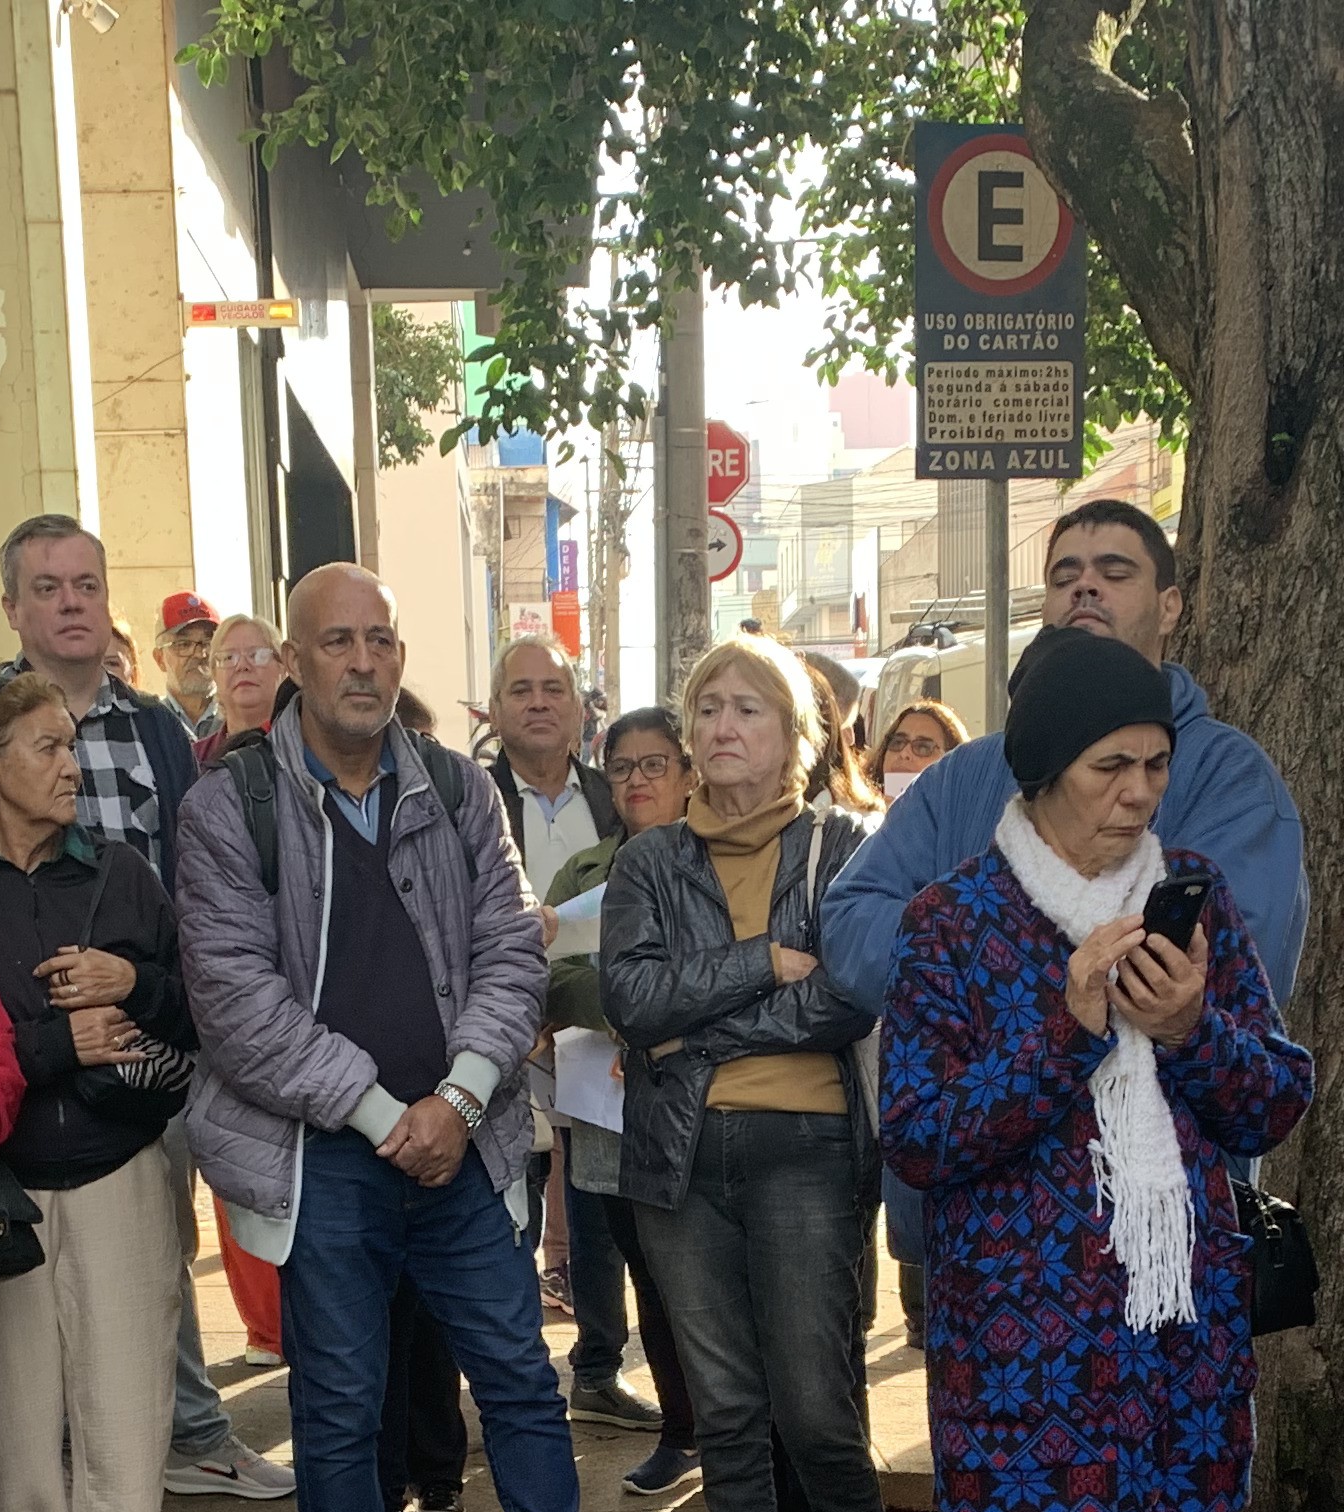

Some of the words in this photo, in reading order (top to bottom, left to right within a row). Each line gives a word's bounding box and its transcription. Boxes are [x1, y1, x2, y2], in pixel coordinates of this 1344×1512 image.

[978, 171, 1024, 262] E
[220, 304, 265, 312] CUIDADO
[924, 313, 956, 330] USO
[963, 309, 1075, 330] OBRIGATÓRIO
[943, 334, 970, 350] DO
[978, 331, 1059, 350] CARTÃO
[928, 381, 992, 395] segunda
[1015, 380, 1069, 393] sábado
[928, 395, 982, 408] horário
[993, 395, 1069, 408] comercial
[929, 411, 962, 423] Dom.
[969, 413, 976, 424] e
[982, 410, 1032, 423] feriado
[1039, 410, 1070, 423] livre
[928, 426, 1005, 440] Proibido
[1014, 426, 1069, 439] motos
[708, 448, 740, 477] RE
[928, 450, 996, 472] ZONA
[1007, 448, 1071, 470] AZUL
[562, 545, 570, 592] DENT
